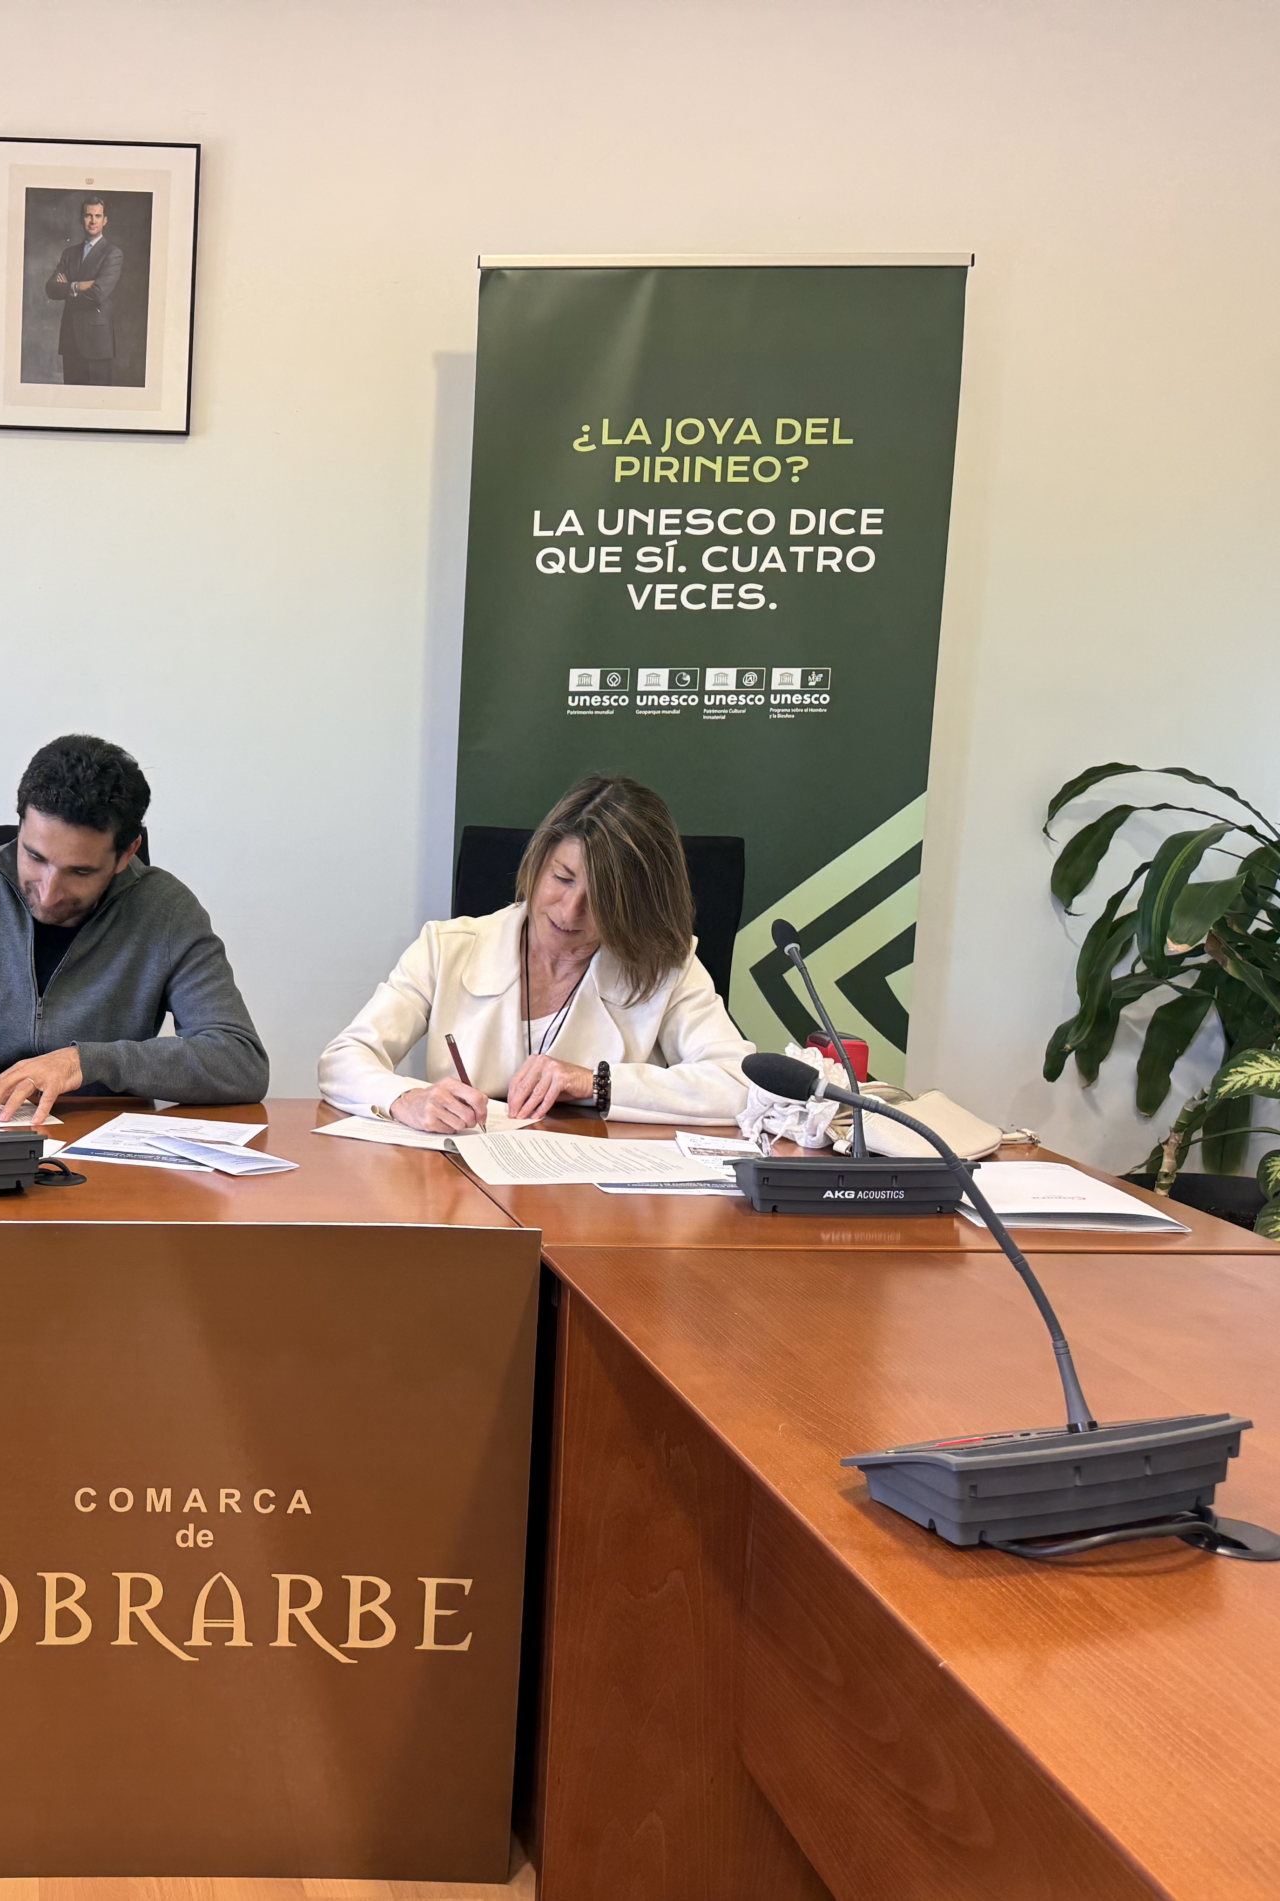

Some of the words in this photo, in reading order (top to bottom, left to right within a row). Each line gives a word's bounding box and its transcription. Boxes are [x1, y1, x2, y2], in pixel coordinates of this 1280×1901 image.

[573, 418, 652, 453] ¿LA
[661, 417, 762, 454] JOYA
[775, 417, 854, 445] DEL
[614, 455, 810, 484] PIRINEO?
[532, 508, 585, 537] LA
[597, 508, 776, 536] UNESCO
[789, 507, 885, 536] DICE
[535, 546, 623, 575] QUE
[634, 539, 687, 574] SÍ.
[701, 545, 876, 573] CUATRO
[626, 583, 778, 611] VECES.
[567, 694, 630, 707] unesco
[635, 694, 699, 706] unesco
[703, 693, 766, 706] unesco
[769, 693, 831, 705] unesco
[822, 1190, 856, 1199] AKG
[856, 1190, 905, 1200] ACOUSTICS
[74, 1486, 312, 1515] COMARCA
[175, 1522, 215, 1549] de
